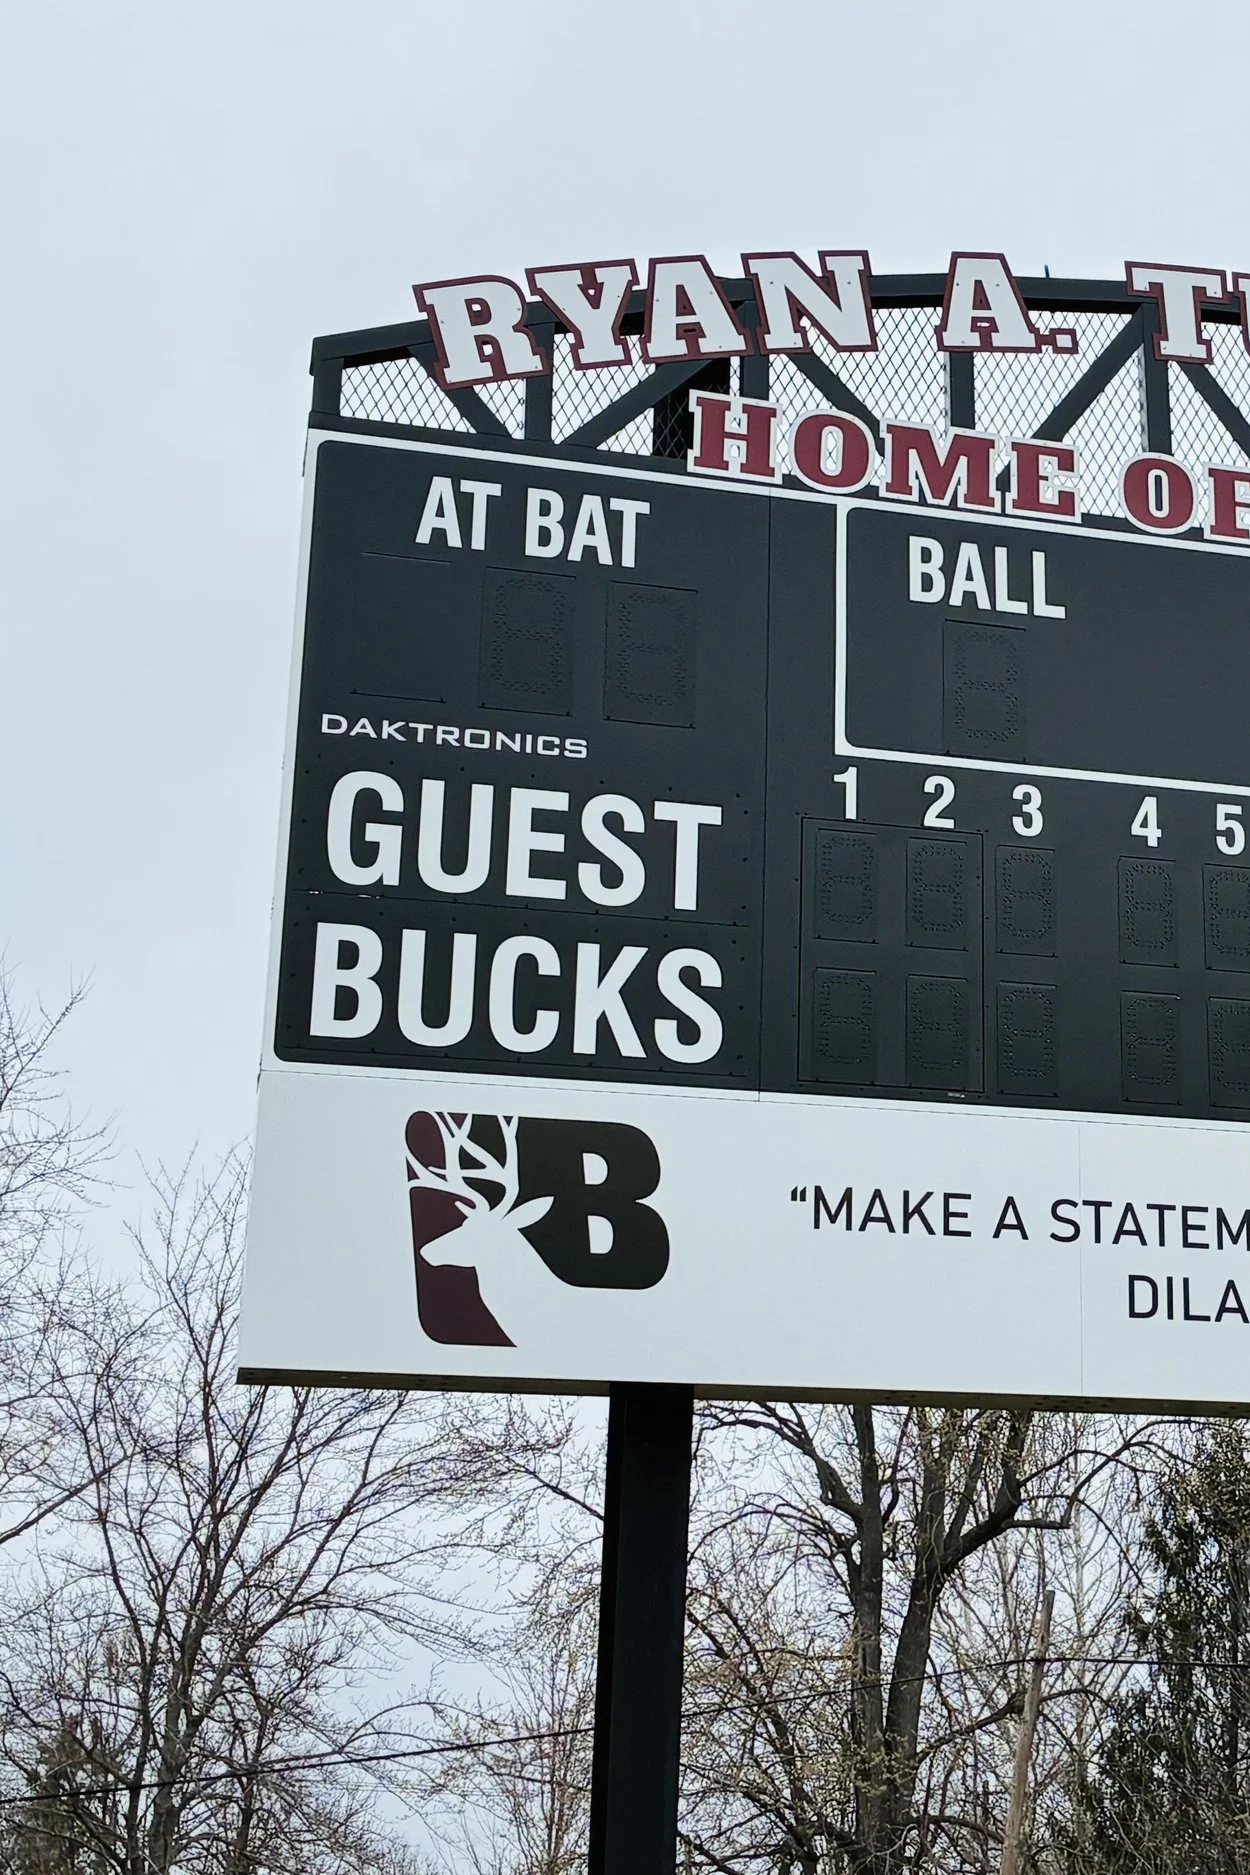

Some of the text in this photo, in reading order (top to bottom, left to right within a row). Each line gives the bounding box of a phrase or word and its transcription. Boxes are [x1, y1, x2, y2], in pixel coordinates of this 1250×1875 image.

[412, 250, 878, 390] RYAN
[935, 251, 1079, 354] A.
[687, 389, 1082, 523] HOME
[416, 477, 651, 567] AT BAT
[910, 536, 1066, 618] BALL
[322, 714, 587, 758] DAKTRONICS
[328, 771, 721, 910] GUEST
[834, 767, 857, 819] 1
[924, 776, 954, 828] 2
[1013, 785, 1043, 836] 3
[1132, 797, 1161, 847] 4
[1216, 804, 1245, 854] 5
[309, 923, 722, 1064] BUCKS
[791, 1186, 971, 1237] “MAKE
[993, 1196, 1028, 1240] A
